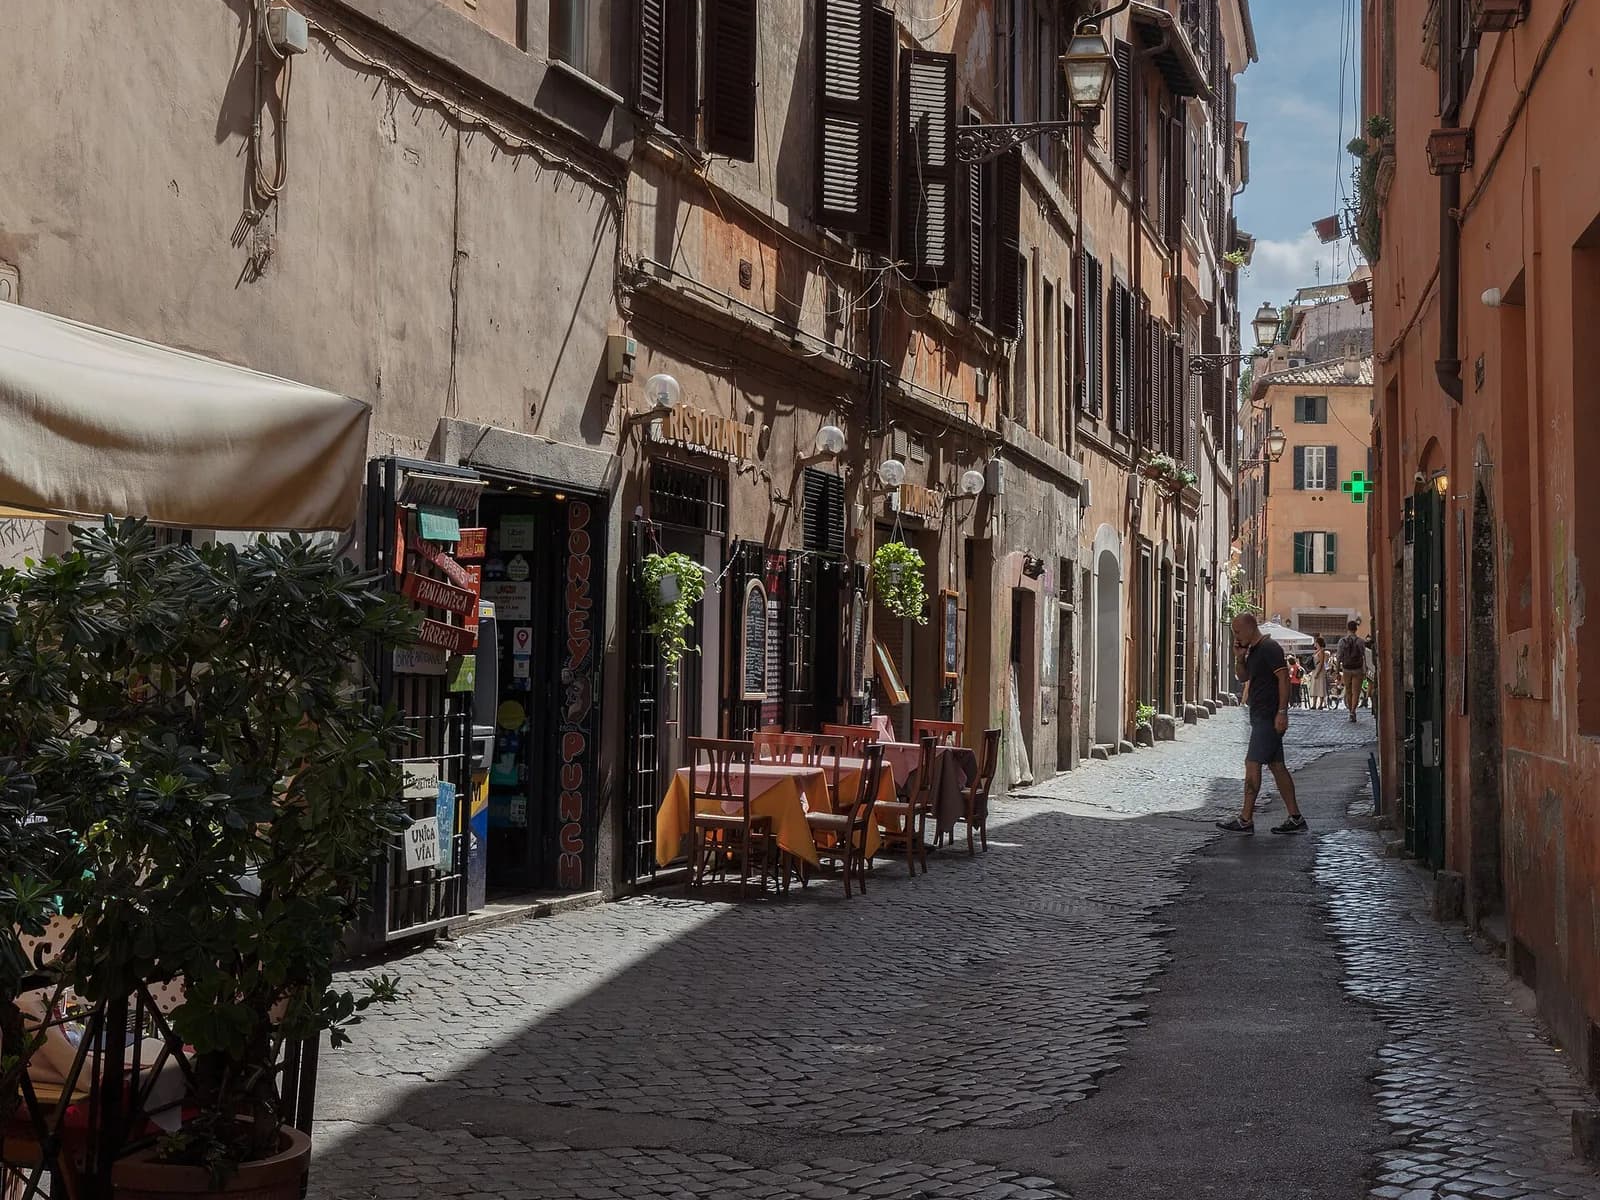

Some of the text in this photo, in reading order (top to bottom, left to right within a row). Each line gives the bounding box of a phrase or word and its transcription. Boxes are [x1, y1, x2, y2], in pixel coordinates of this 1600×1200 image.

[664, 402, 753, 459] RISTORANTE
[416, 580, 468, 612] PANINOTECA
[565, 501, 592, 670] DONKEY
[558, 731, 586, 889] PUNCH
[411, 824, 436, 844] UNICA
[415, 844, 435, 862] VIA!
